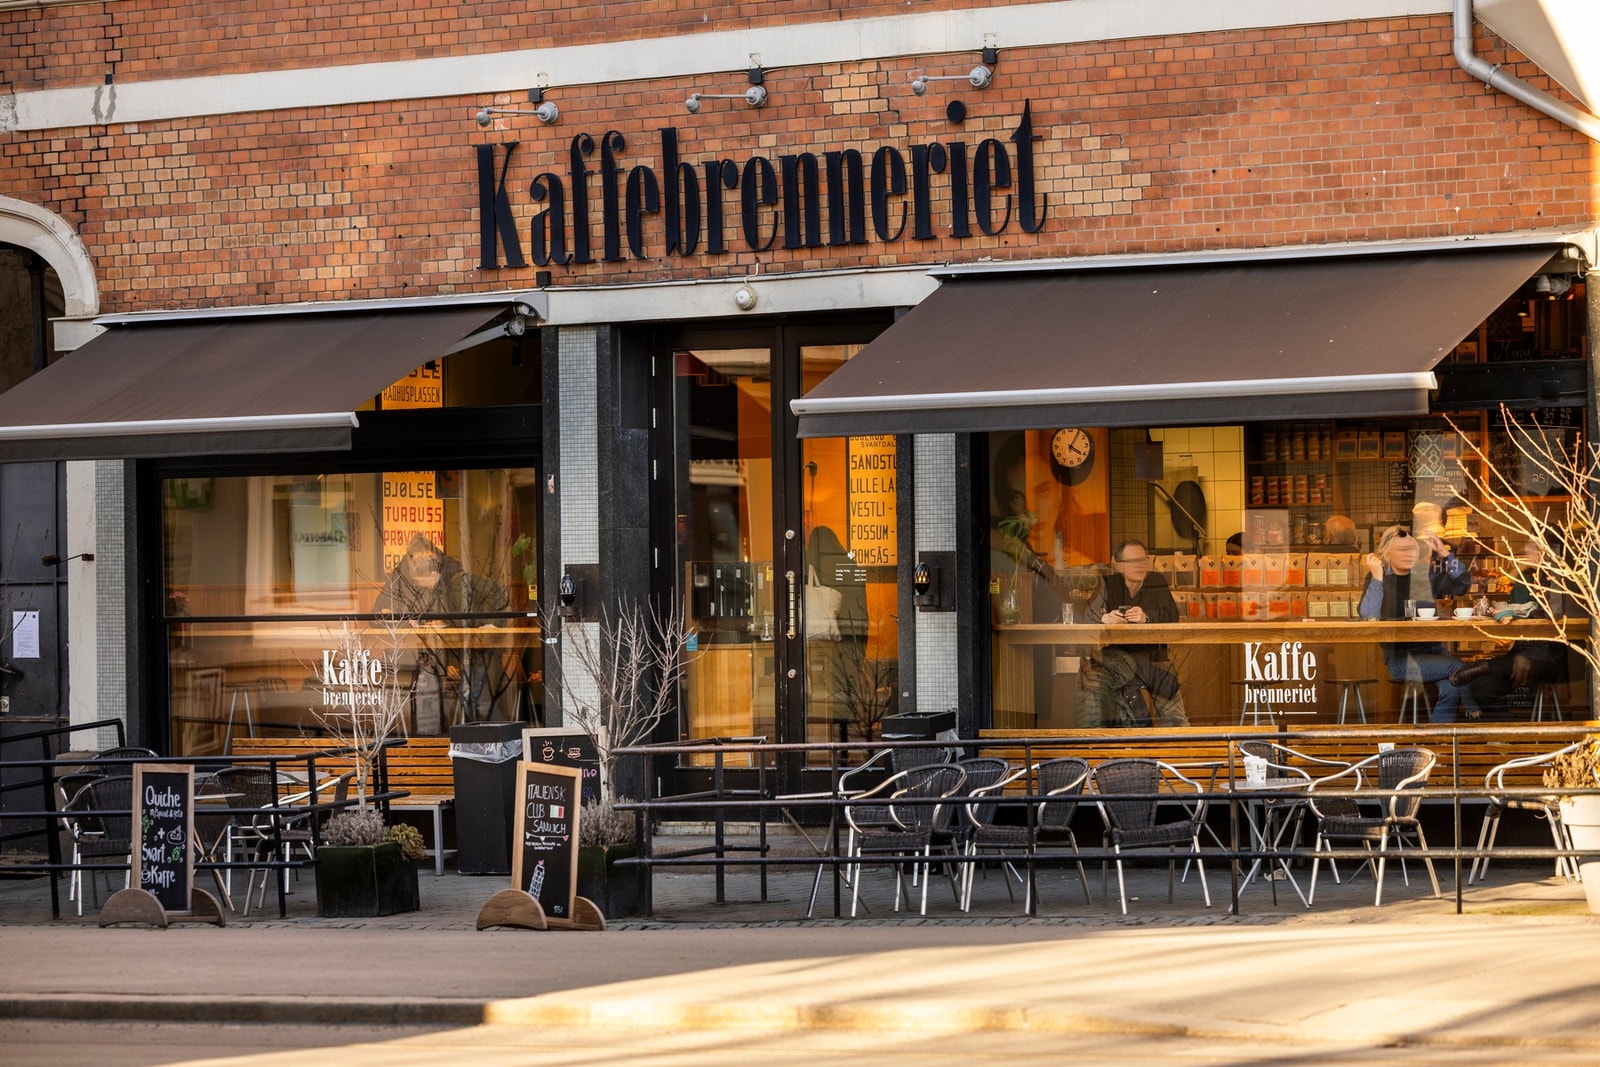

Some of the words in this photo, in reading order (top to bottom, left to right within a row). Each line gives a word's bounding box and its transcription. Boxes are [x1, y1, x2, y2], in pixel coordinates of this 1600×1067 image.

[473, 98, 1047, 269] Kaffebrenneriet
[850, 477, 878, 493] LILLE
[881, 477, 897, 493] LA
[1531, 473, 1546, 484] 25
[383, 481, 433, 499] BJØLSE
[384, 506, 442, 523] TURBUSS
[850, 501, 885, 517] VESTLI
[322, 649, 382, 685] Kaffe
[1243, 641, 1317, 681] Kaffe
[323, 687, 383, 706] brenneriet
[1245, 683, 1318, 704] brenneriet
[145, 785, 181, 807] Quiche
[527, 784, 567, 802] ITALIENSK
[526, 802, 546, 819] CLUB
[142, 843, 166, 864] Svart
[150, 865, 176, 889] Kaffe
